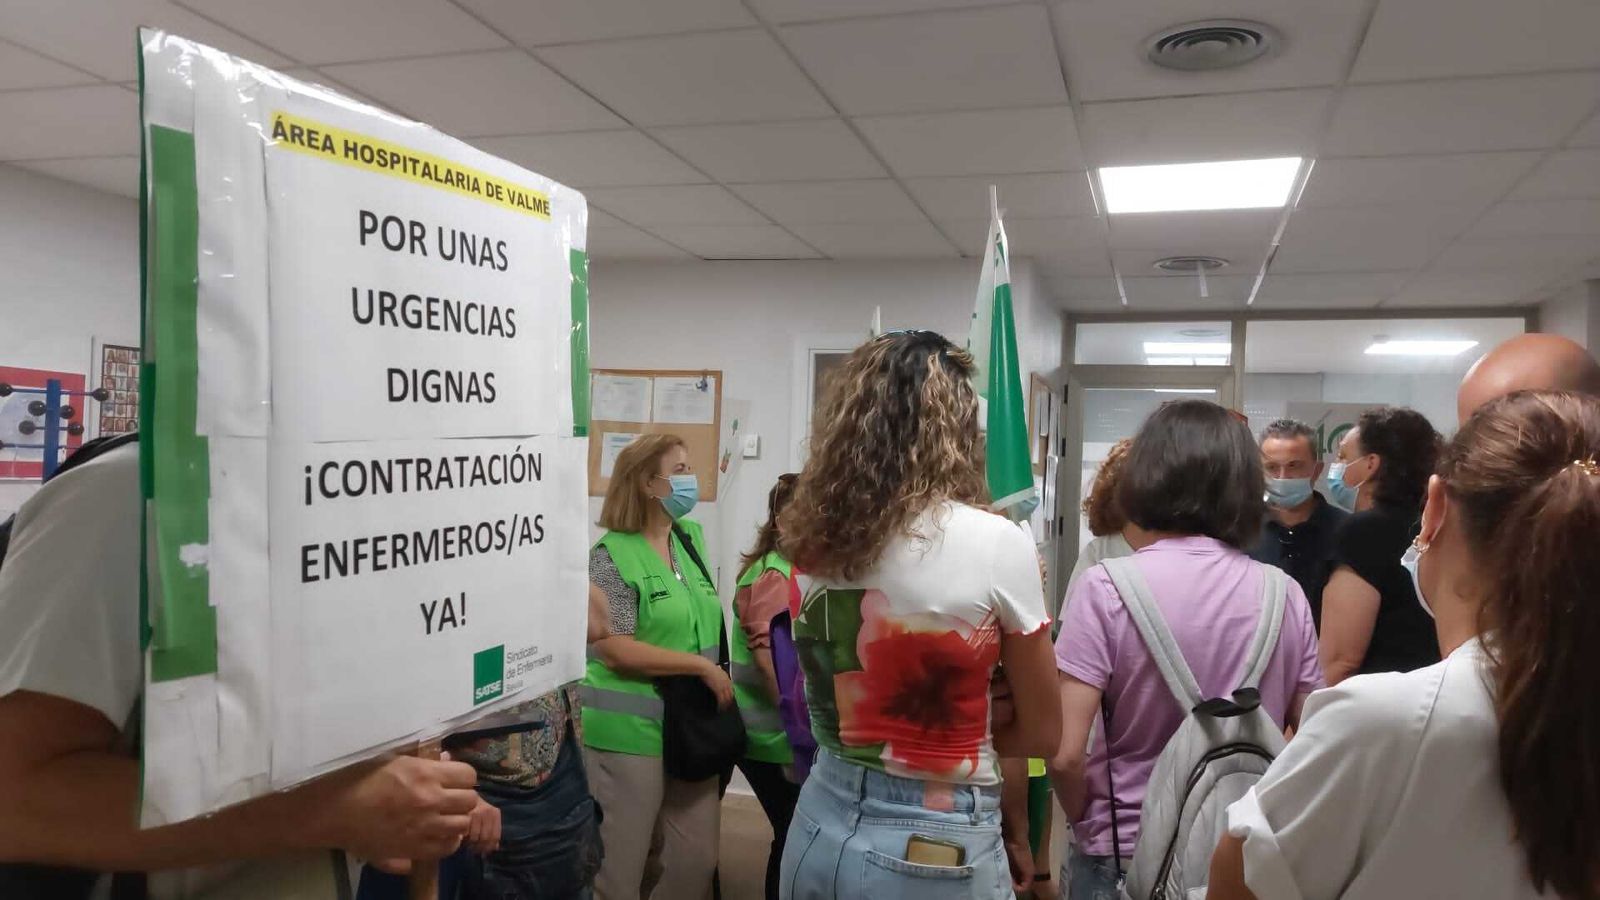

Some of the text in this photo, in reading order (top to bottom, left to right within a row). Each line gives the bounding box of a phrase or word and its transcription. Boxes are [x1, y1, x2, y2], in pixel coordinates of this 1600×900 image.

[272, 115, 551, 216] ÁREA HOSPITALARIA DE VALME
[359, 210, 508, 272] POR UNAS
[352, 287, 516, 338] URGENCIAS
[387, 367, 496, 404] DIGNAS
[304, 445, 543, 506] ¡CONTRATACIÓN
[301, 514, 545, 584] ENFERMEROS/AS
[420, 592, 467, 635] YA!
[475, 680, 502, 700] SATSE
